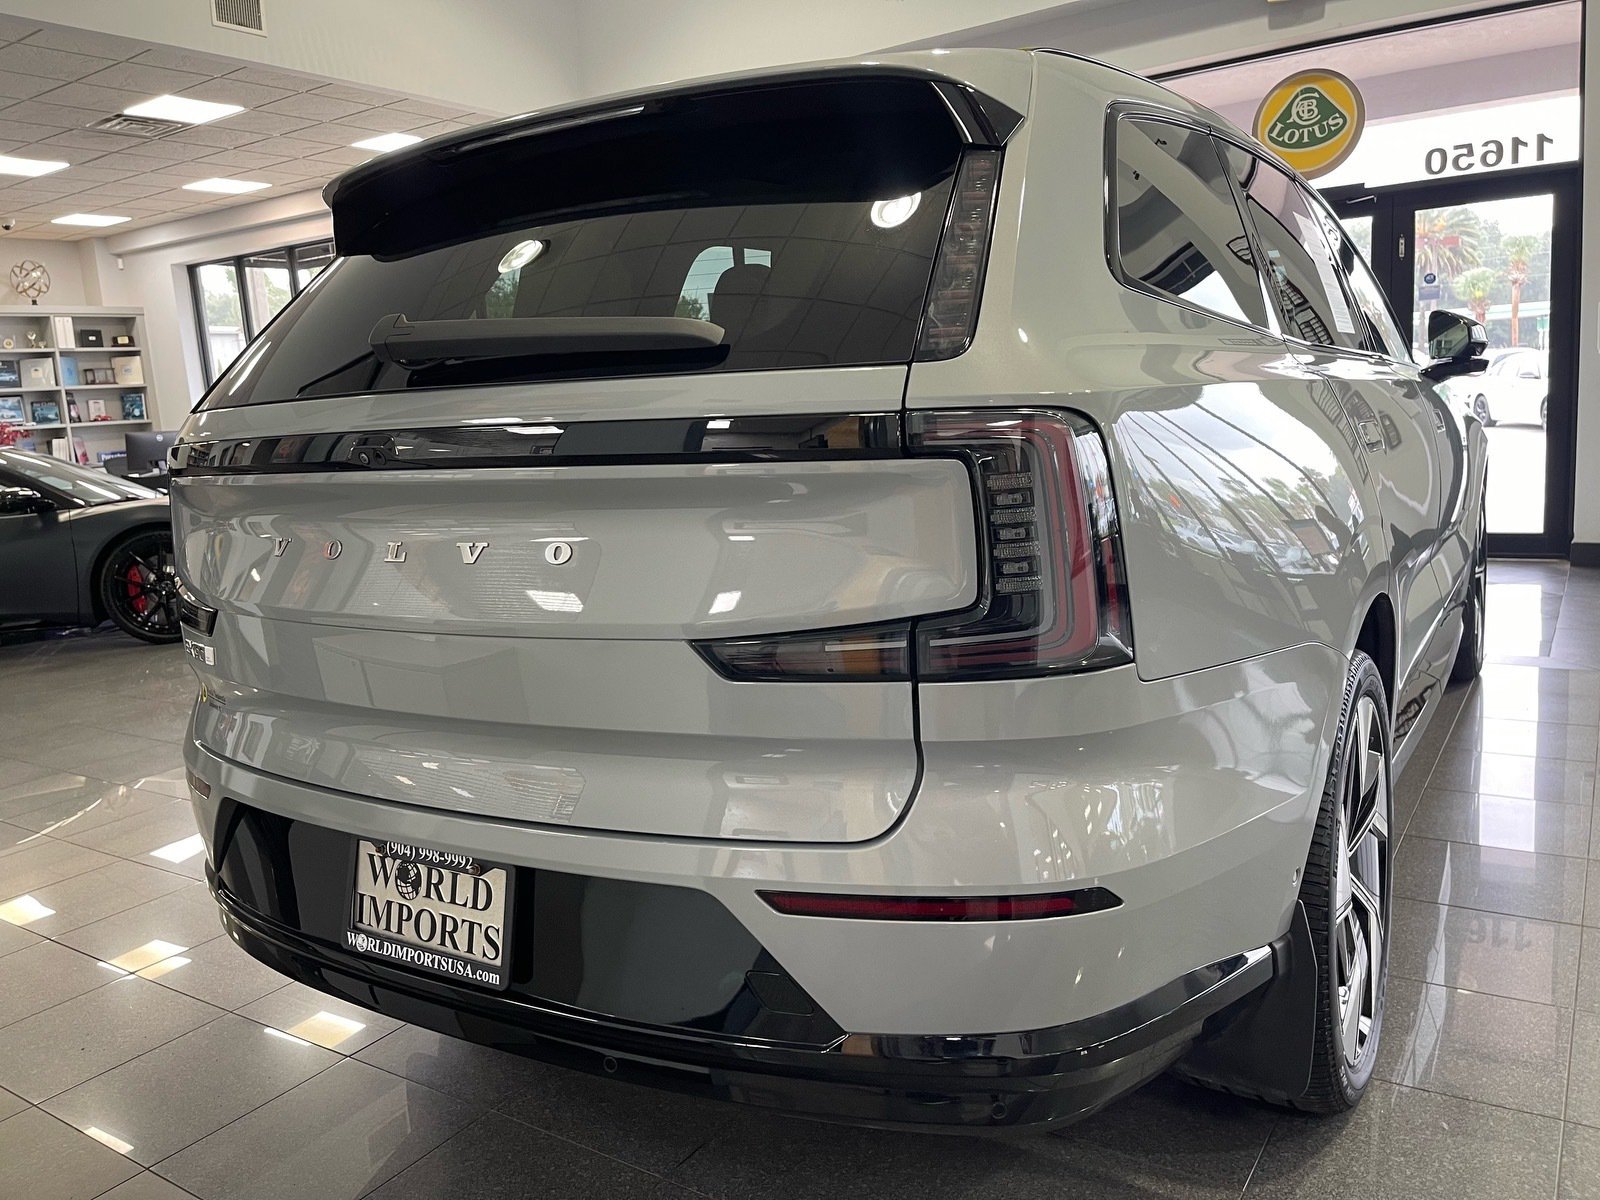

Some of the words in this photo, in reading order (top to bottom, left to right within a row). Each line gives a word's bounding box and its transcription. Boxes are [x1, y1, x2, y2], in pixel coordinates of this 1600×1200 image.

[1269, 112, 1344, 144] LOTUS
[272, 537, 573, 566] VOLVO
[385, 841, 416, 860] (904)
[418, 848, 474, 869] 998-9992
[367, 853, 493, 912] WORLD
[356, 893, 501, 961] IMPORTS
